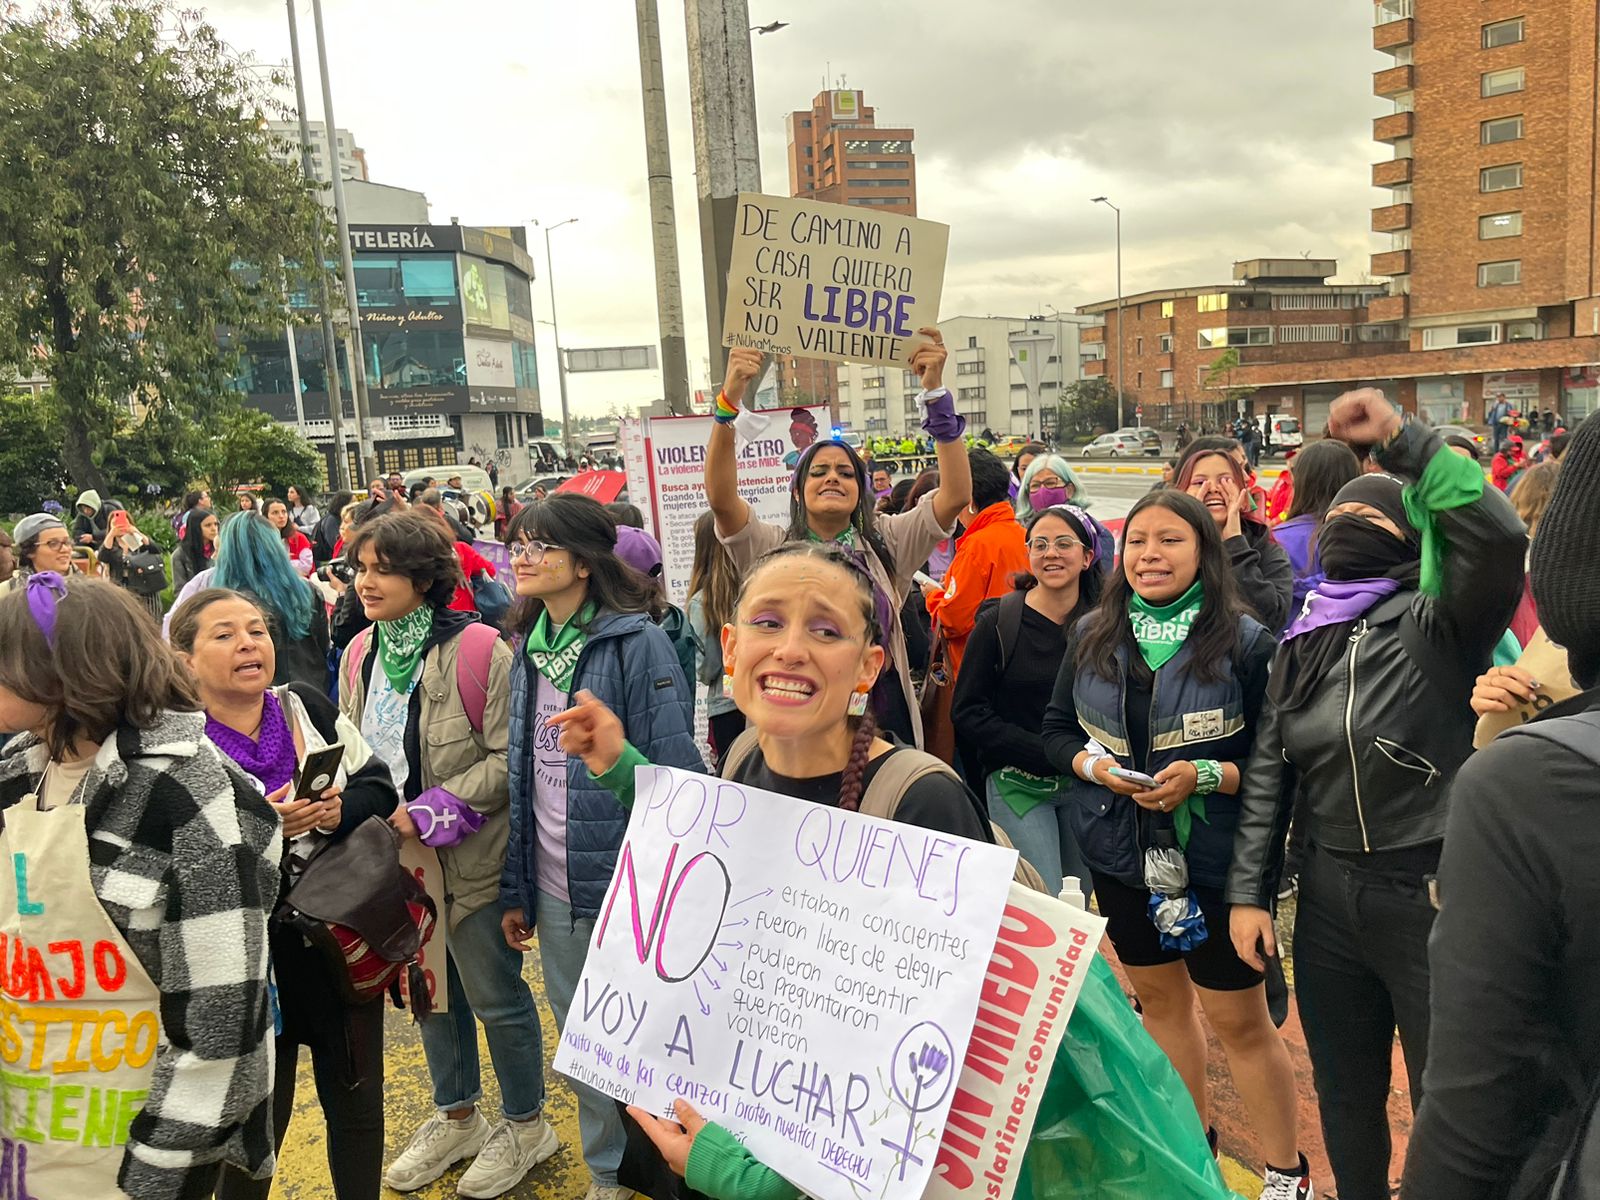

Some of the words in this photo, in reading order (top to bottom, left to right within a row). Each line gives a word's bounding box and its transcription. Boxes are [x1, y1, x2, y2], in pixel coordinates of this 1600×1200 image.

[349, 226, 434, 248] TELERÍA
[741, 203, 779, 240] DE
[791, 211, 881, 250] CAMINO
[895, 227, 911, 256] A
[755, 246, 810, 280] CASA
[832, 255, 912, 293] QUIERO
[408, 310, 444, 322] Adultos
[743, 276, 782, 310] SER
[803, 283, 916, 337] LIBRE
[745, 312, 778, 336] NO
[797, 325, 903, 362] VALIENTE
[658, 465, 669, 476] La
[671, 462, 704, 474] violenci
[759, 456, 781, 467] MIDE
[662, 483, 689, 493] Busca
[662, 492, 694, 503] Cuando
[777, 484, 787, 492] de
[663, 501, 697, 512] mujeres
[1132, 621, 1190, 641] LIBRE
[548, 638, 584, 681] IBRE
[641, 767, 747, 849] POR
[795, 806, 971, 917] QUIENES
[597, 840, 732, 983] NO
[782, 886, 850, 922] estaban
[862, 912, 970, 960] conscientes
[748, 942, 821, 982] pudieron
[834, 974, 918, 1016] consentir
[816, 922, 857, 966] libres
[862, 944, 885, 973] de
[895, 952, 952, 991] elegir
[733, 987, 803, 1031] querían
[774, 976, 879, 1032] preguntaron
[963, 903, 1057, 1086] MIEDO
[727, 1011, 808, 1054] volvieron
[564, 1026, 591, 1053] hasta
[594, 1041, 613, 1068] que
[616, 1054, 631, 1078] de
[636, 1058, 655, 1088] las
[665, 1072, 729, 1114] cenizas
[735, 1096, 771, 1128] broten
[583, 978, 648, 1046] VOY
[664, 1014, 696, 1066] A
[729, 1039, 870, 1148] LUCHAR
[982, 926, 1090, 1200] slatinas.comunidad
